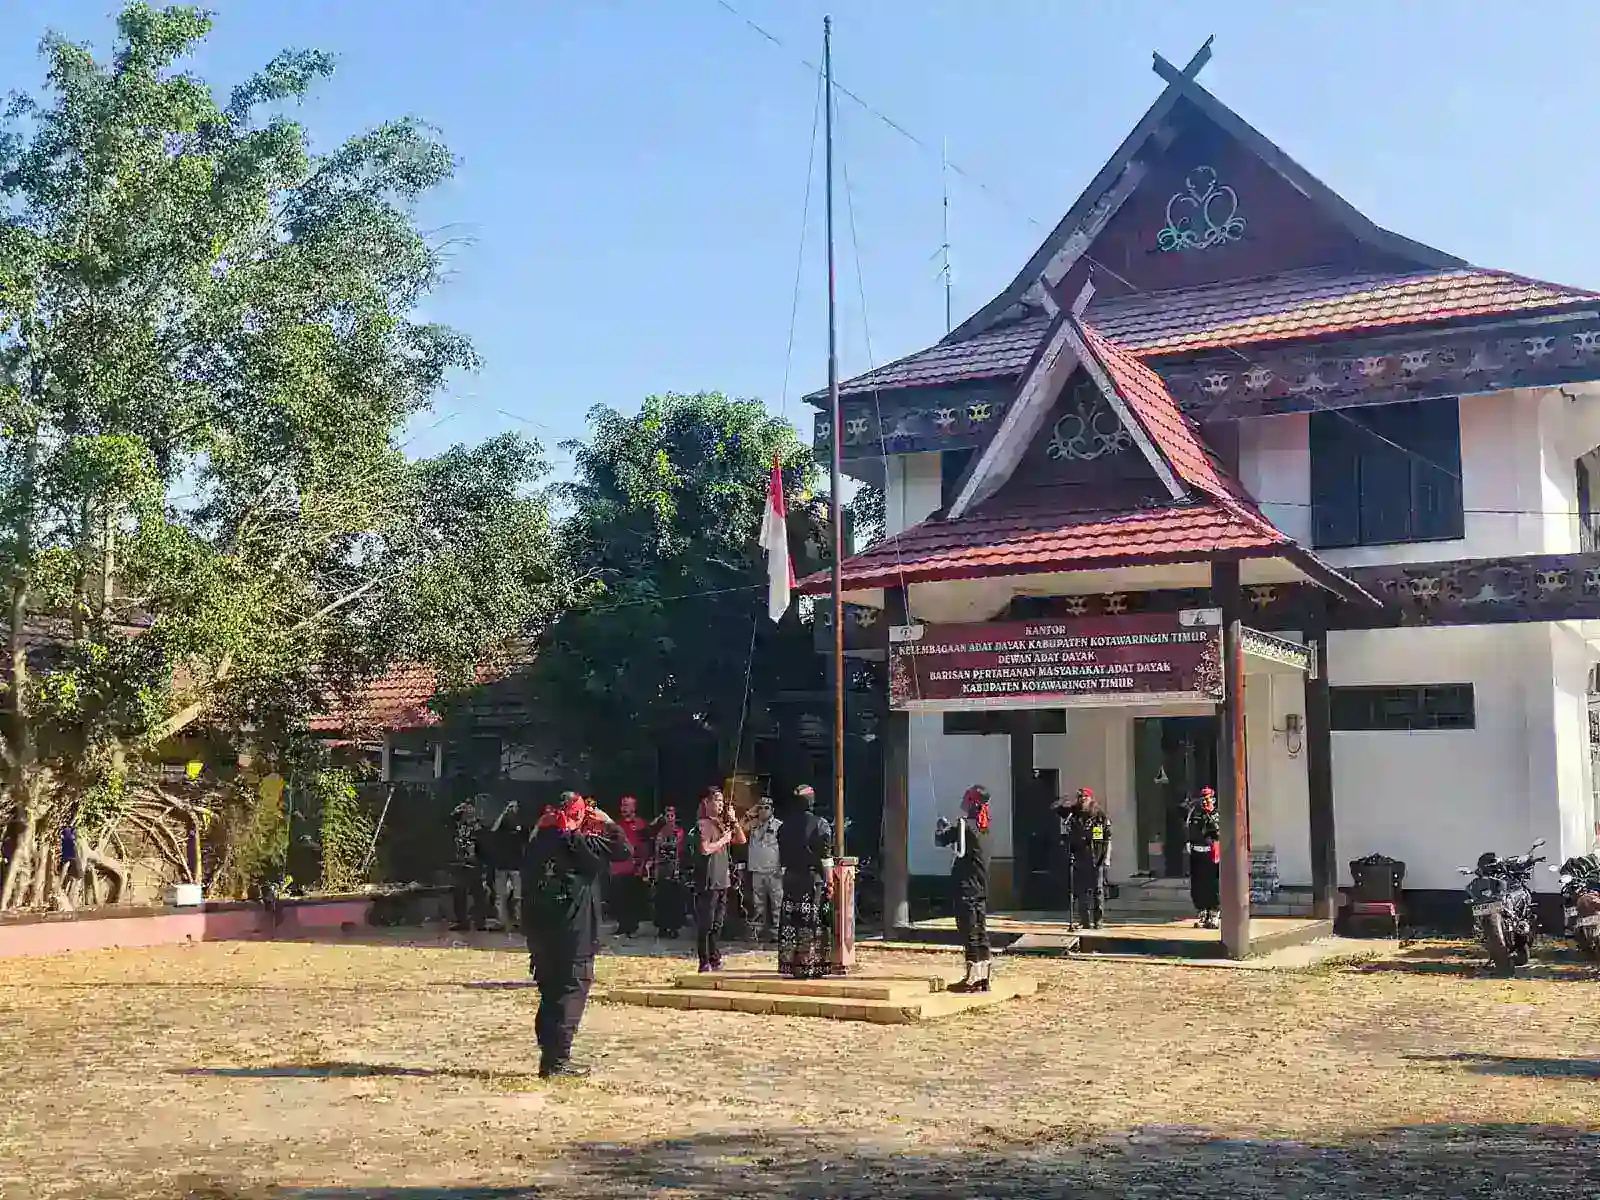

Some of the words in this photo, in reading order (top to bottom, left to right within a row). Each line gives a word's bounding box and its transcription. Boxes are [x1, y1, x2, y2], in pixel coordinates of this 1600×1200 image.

[1025, 625, 1066, 635] KANTOR
[968, 642, 993, 652] ADAT
[995, 640, 1026, 651] DAYAK
[1028, 637, 1088, 649] KABUPATEN
[1091, 633, 1169, 646] KOTAWARINGIN
[1171, 631, 1207, 642] TIMUR
[998, 653, 1032, 664] DEWAN
[1034, 652, 1060, 663] ADAT
[1062, 651, 1096, 661] DAYAK
[930, 670, 971, 681] BARISAN
[973, 667, 1036, 679] PERTAHANAN
[1038, 664, 1106, 676] MASYARAKAT
[1108, 663, 1135, 674] ADAT
[1136, 662, 1171, 672] DAYAK
[962, 681, 1020, 693] KABUPATEN
[1022, 678, 1098, 691] KOTAWARINGIN
[1099, 677, 1134, 688] TIMUR
